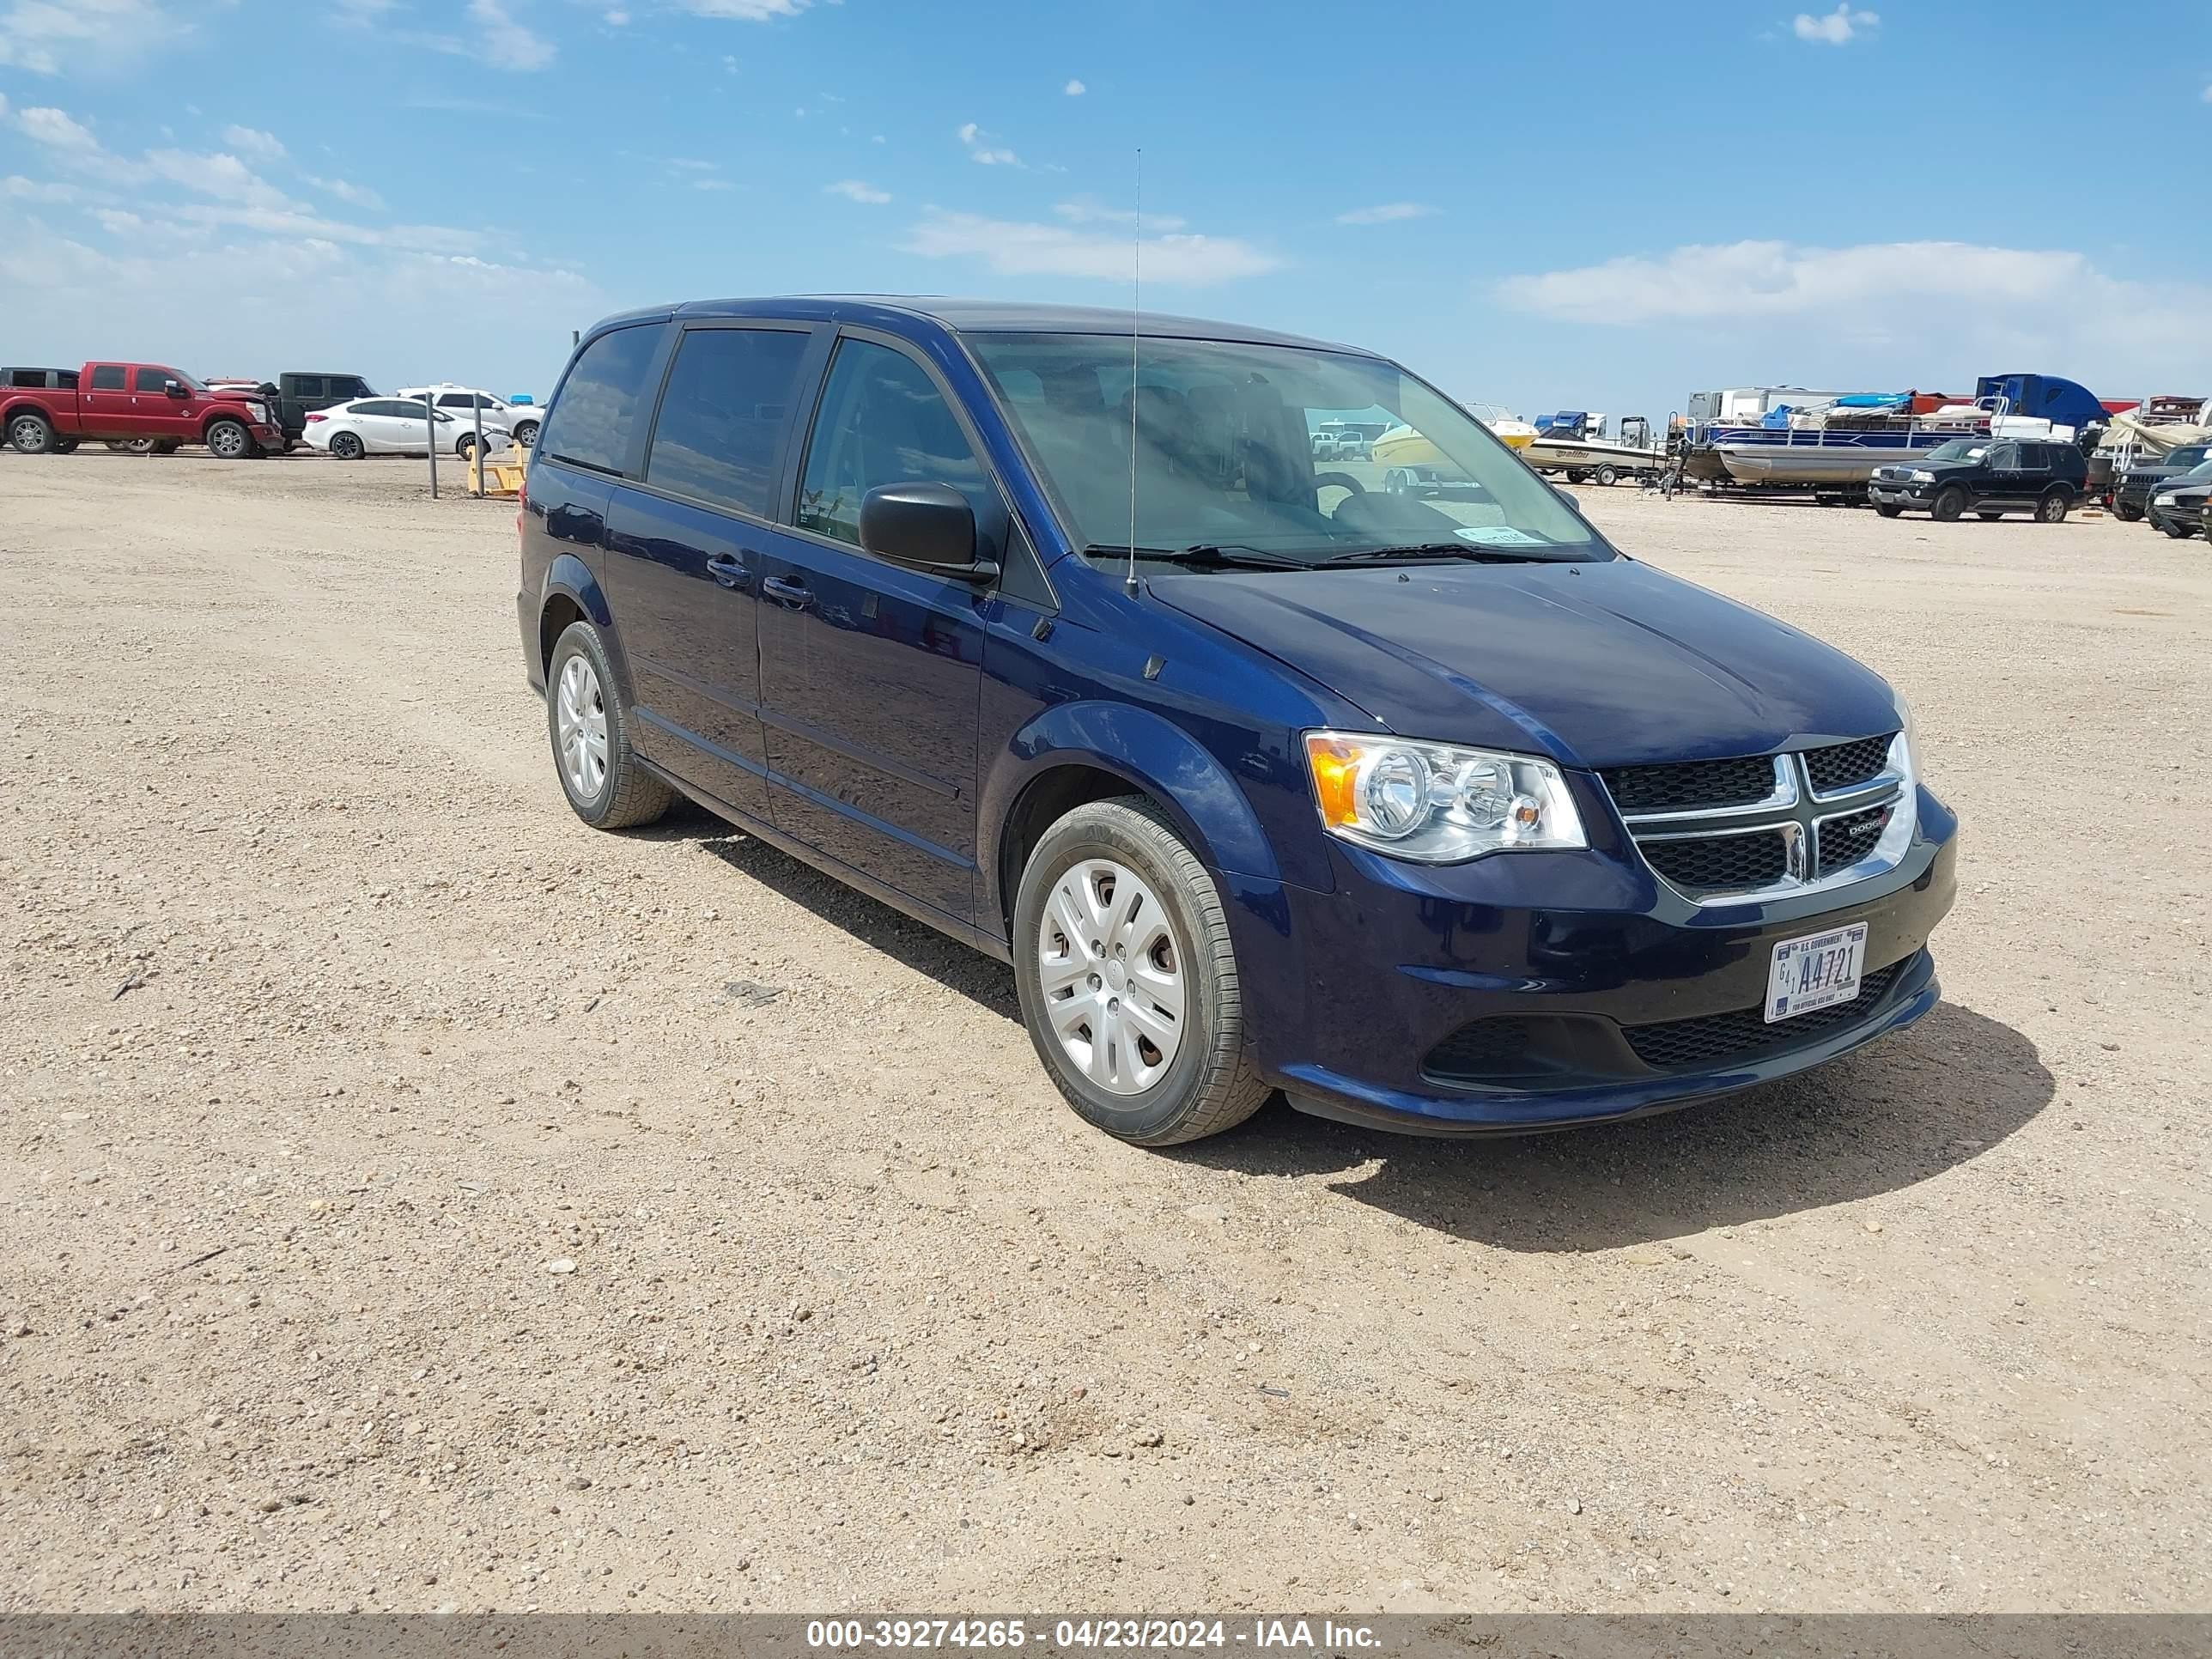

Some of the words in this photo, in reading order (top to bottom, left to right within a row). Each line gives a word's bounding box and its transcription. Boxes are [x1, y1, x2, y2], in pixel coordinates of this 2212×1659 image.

[1849, 819, 1883, 834] DODGE
[1800, 942, 1810, 952] U.S.
[1811, 934, 1843, 951] GOVERNMENT
[1797, 945, 1854, 994] A4721
